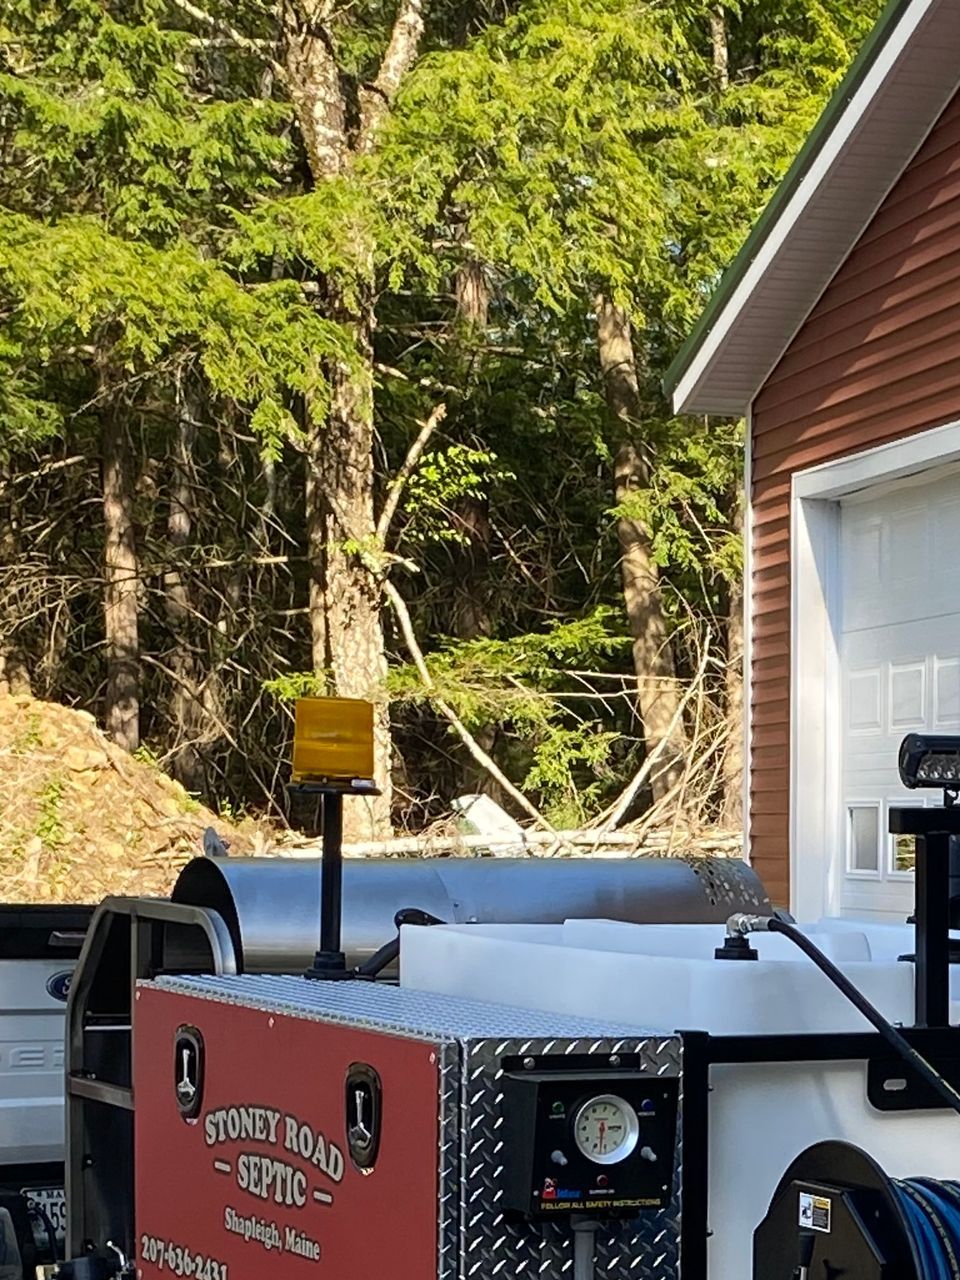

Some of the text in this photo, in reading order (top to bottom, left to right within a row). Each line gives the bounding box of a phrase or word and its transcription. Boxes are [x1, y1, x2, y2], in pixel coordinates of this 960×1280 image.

[205, 1107, 344, 1182] STONEY ROAD
[237, 1154, 307, 1206] SEPTIC
[225, 1207, 320, 1261] Shapleigh, Maine
